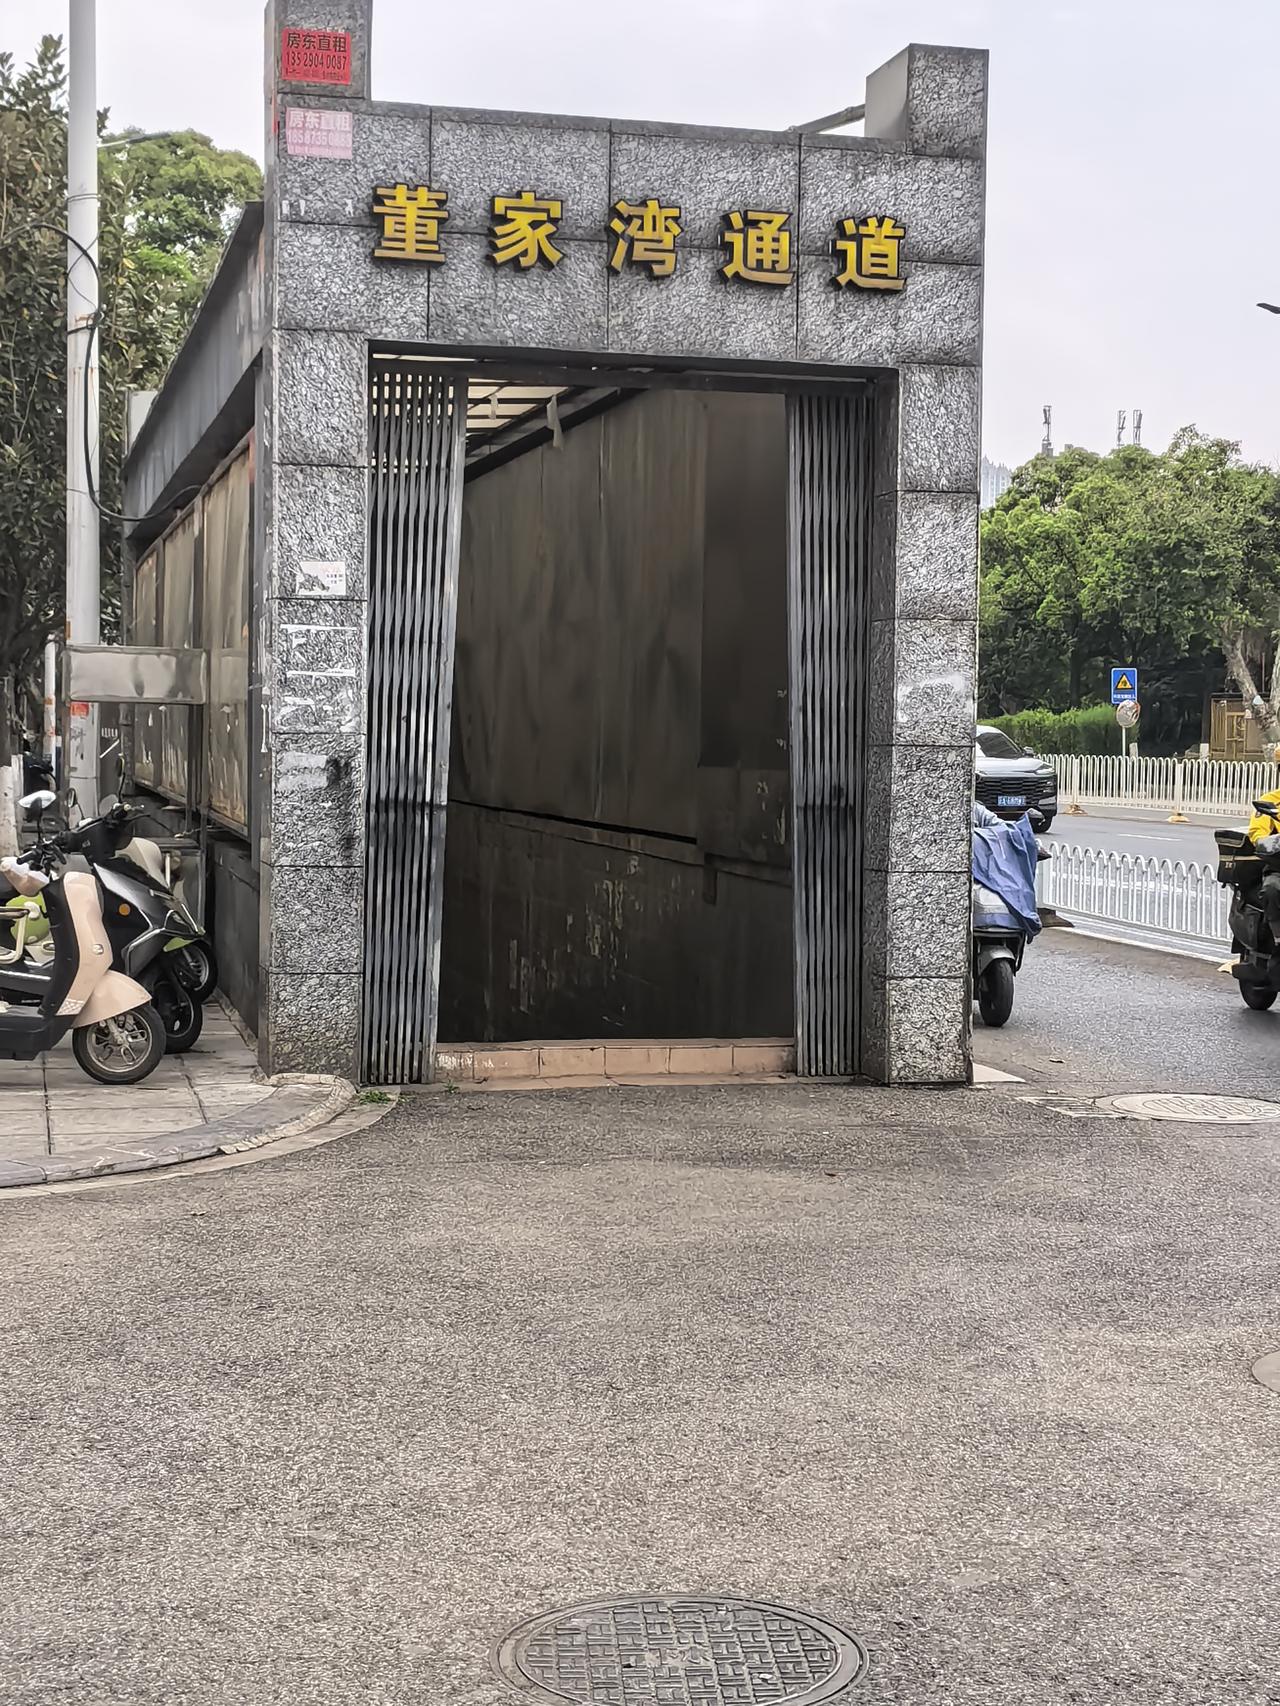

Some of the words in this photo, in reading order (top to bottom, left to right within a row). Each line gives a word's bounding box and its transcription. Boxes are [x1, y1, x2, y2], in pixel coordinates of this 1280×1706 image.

[287, 32, 346, 52] 房东直租
[372, 184, 906, 293] 董家湾通道
